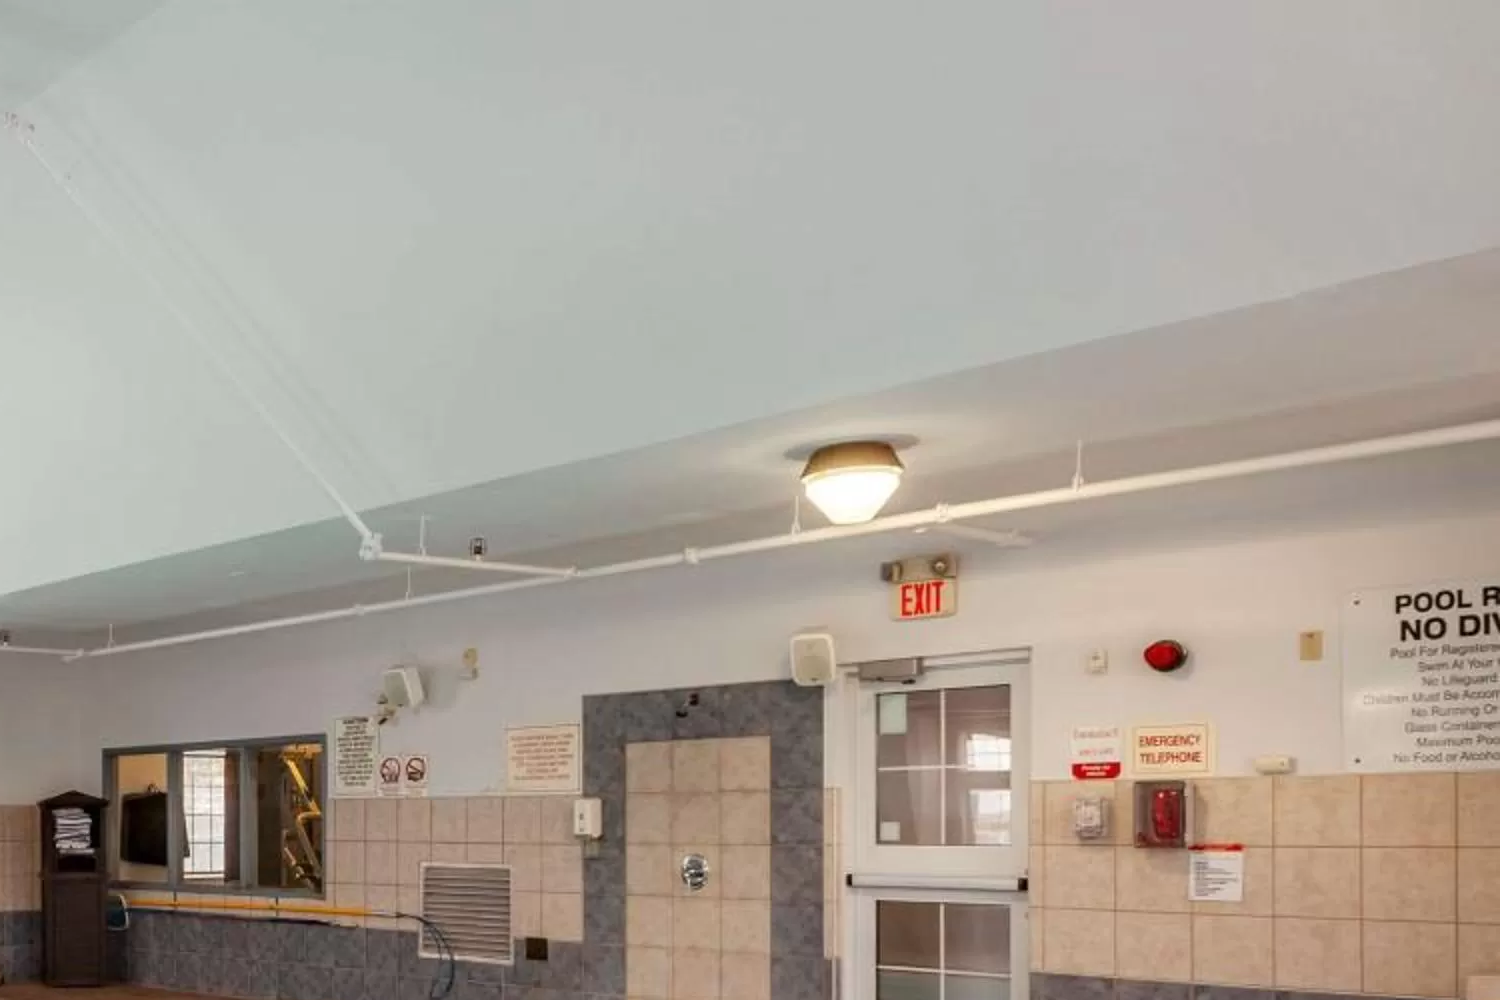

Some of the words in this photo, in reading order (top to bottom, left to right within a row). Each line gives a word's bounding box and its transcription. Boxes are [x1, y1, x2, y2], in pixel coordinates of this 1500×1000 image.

[902, 581, 944, 616] EXIT
[1395, 589, 1473, 614] POOL
[1400, 617, 1447, 642] NO
[1389, 647, 1416, 659] Pool
[1419, 645, 1439, 657] For
[1451, 660, 1465, 670] At
[1468, 658, 1493, 669] Your
[1443, 690, 1461, 702] Be
[1139, 733, 1201, 748] EMERGENCY
[1139, 751, 1202, 764] TELEPHONE
[1413, 751, 1443, 763] Food
